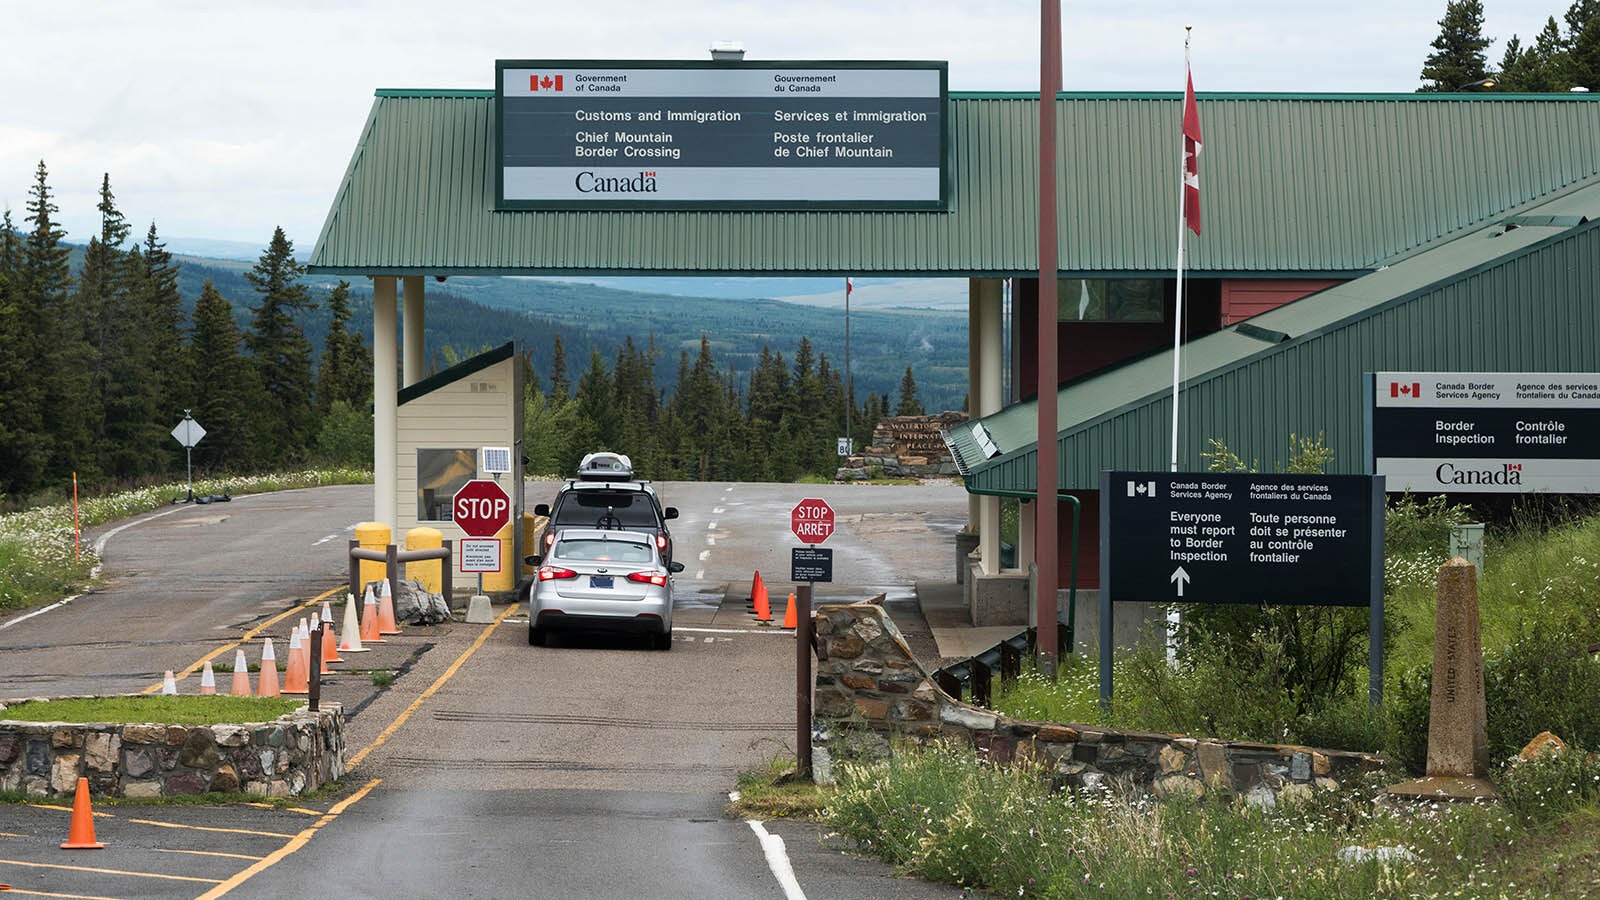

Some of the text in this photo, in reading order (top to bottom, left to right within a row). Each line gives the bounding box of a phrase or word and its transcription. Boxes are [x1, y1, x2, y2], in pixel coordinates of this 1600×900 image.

[575, 74, 627, 83] Government
[774, 74, 836, 83] Gouvernement
[575, 84, 621, 92] of Canada
[575, 110, 741, 123] Customs and Immigration
[774, 110, 927, 123] Services et immigration
[575, 131, 673, 142] Chief Mountain
[774, 132, 874, 143] Poste frontalier
[575, 146, 681, 159] Border Crossing
[774, 146, 893, 157] de Chief Mountain
[575, 171, 657, 193] Canada
[1516, 383, 1545, 392] Agence
[1436, 391, 1500, 400] Services Agency
[1571, 392, 1600, 400] Canada
[1436, 421, 1474, 431] Border
[1516, 420, 1565, 431] Contrôle
[1436, 434, 1495, 445] Inspection
[1516, 434, 1567, 444] frontalier
[1436, 463, 1521, 485] Canada
[1170, 481, 1227, 490] Canada Border
[1250, 483, 1278, 492] Agence
[1170, 490, 1232, 500] Services Agency
[1303, 492, 1332, 500] Canada
[457, 498, 507, 519] STOP
[798, 506, 828, 519] STOP
[1170, 511, 1221, 524] Everyone
[1250, 512, 1336, 525] Toute personne
[796, 522, 832, 536] ARRÊT
[1170, 525, 1235, 537] must report
[1250, 526, 1346, 539] doit se présenter
[1170, 537, 1223, 547] to Border
[1250, 539, 1313, 550] au contrôle
[1170, 550, 1227, 563] Inspection
[1250, 552, 1300, 562] frontalier
[1447, 626, 1456, 703] UNITED STATES
